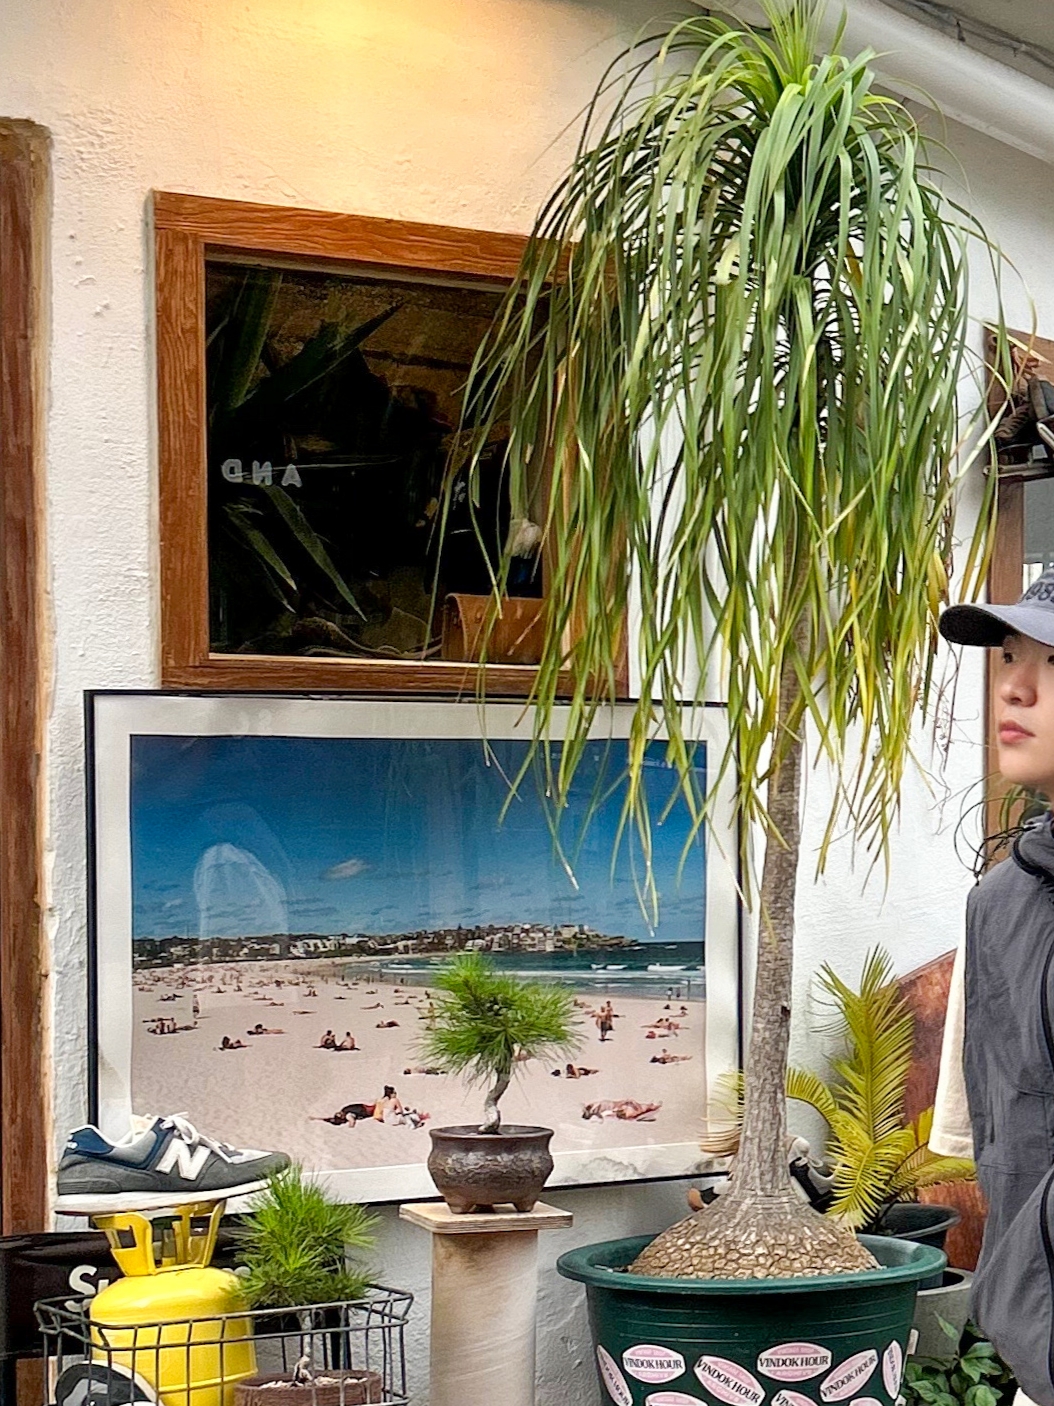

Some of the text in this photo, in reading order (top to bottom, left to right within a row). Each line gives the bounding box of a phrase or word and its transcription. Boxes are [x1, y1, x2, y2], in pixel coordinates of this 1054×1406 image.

[655, 1358, 683, 1370] HOUR
[800, 1355, 829, 1367] HOUR
[854, 1354, 877, 1379] HOUR
[731, 1381, 761, 1404] HOUR
